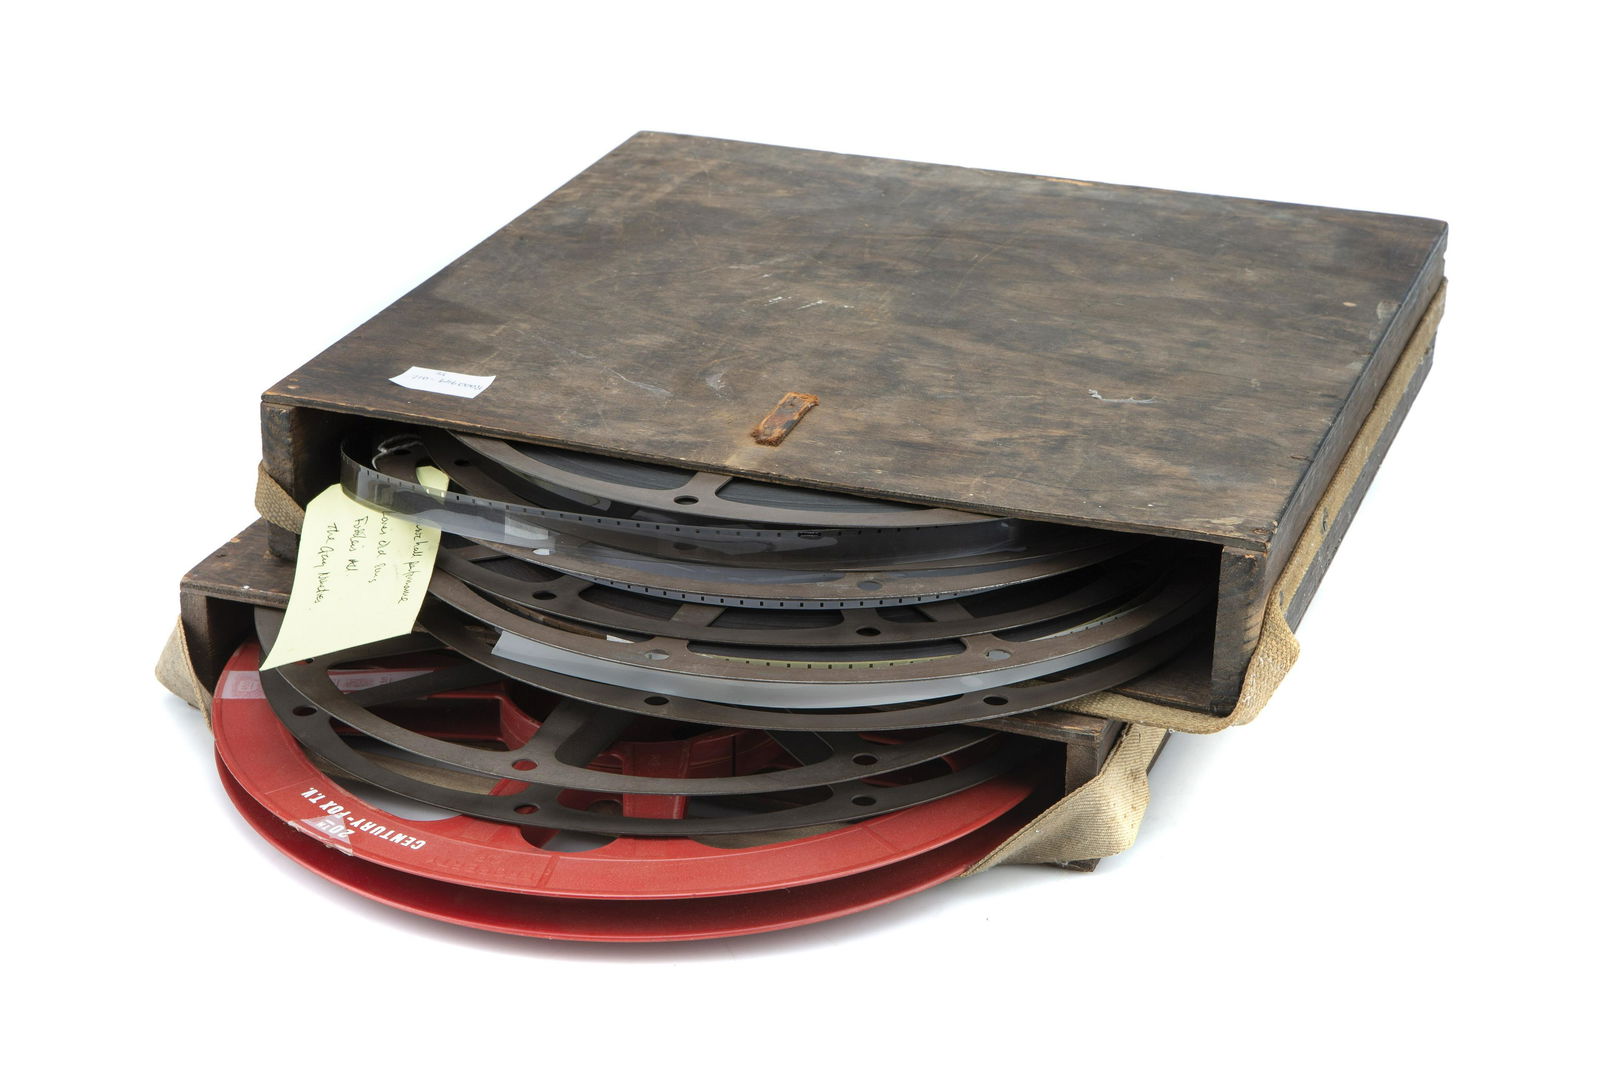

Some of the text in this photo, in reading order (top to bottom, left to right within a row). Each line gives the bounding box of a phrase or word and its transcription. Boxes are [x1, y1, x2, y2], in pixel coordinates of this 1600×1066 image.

[325, 522, 340, 544] The
[314, 545, 335, 568] Gay
[300, 787, 427, 851] CENTURY-FOX T.V.
